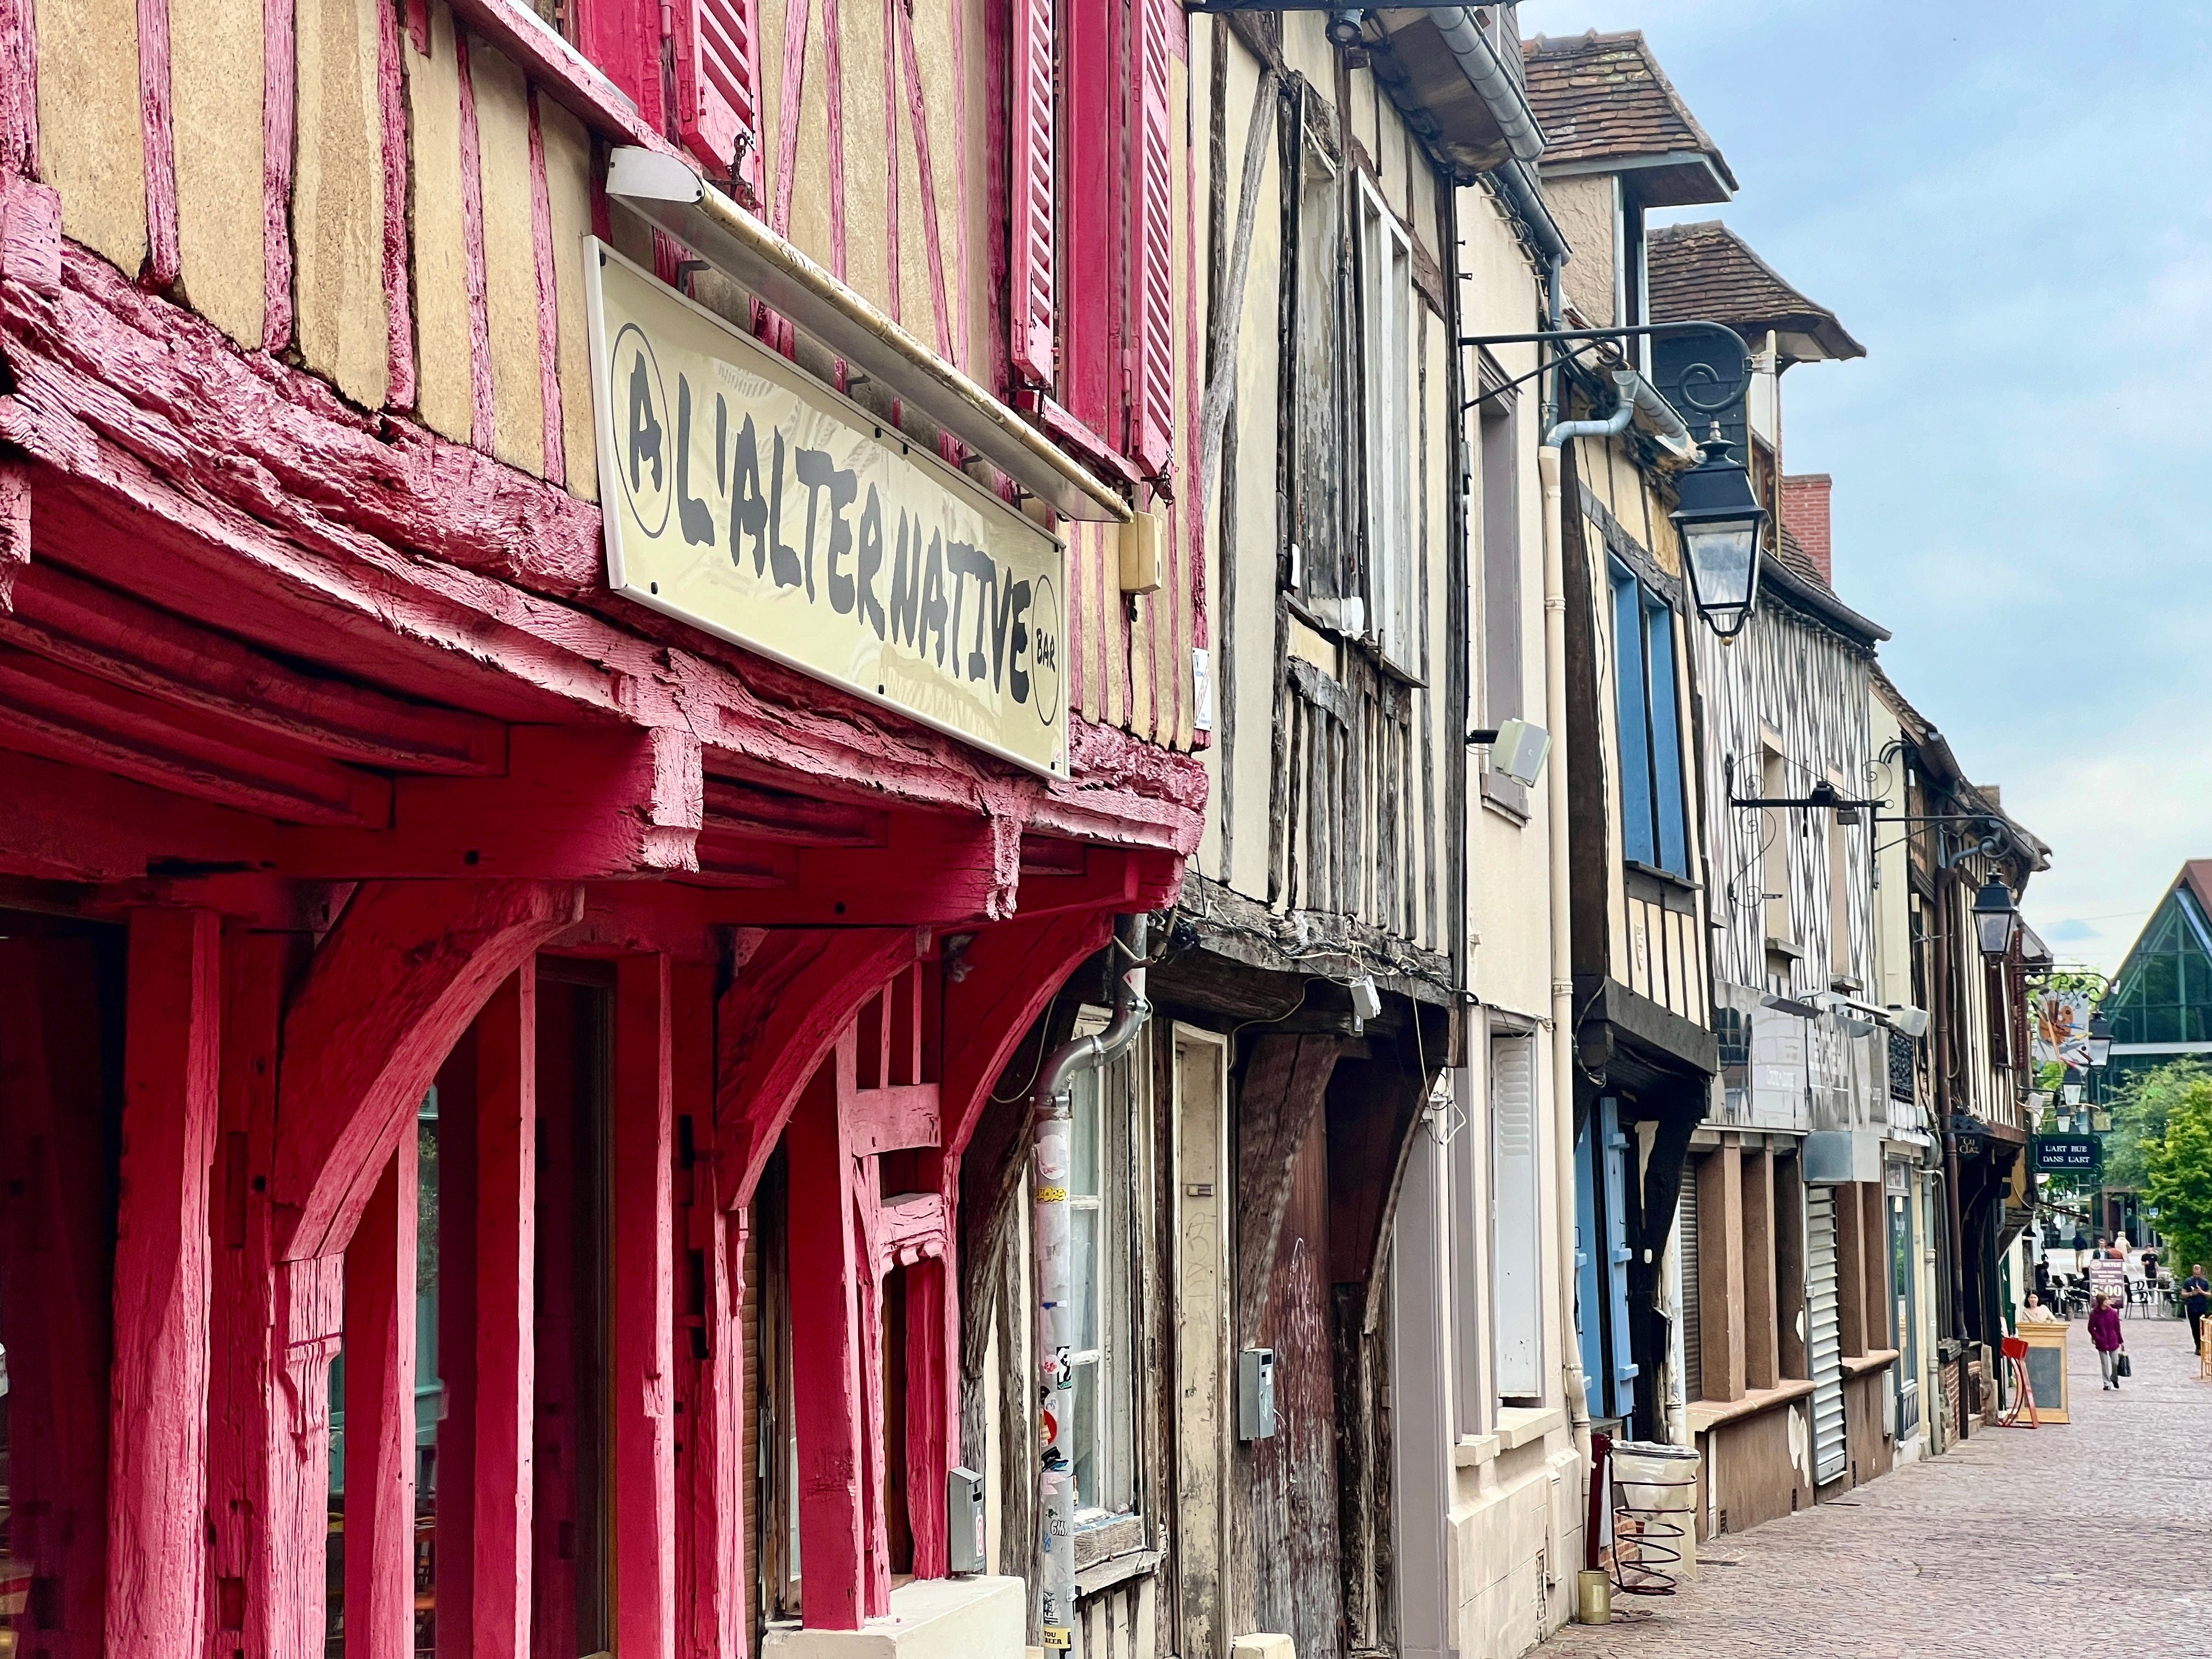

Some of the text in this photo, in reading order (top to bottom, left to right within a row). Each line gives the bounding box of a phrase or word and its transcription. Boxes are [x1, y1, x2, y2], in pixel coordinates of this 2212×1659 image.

[629, 349, 662, 494] A
[677, 371, 1031, 704] L'ALTERNATIVE
[1035, 626, 1056, 673] BAR
